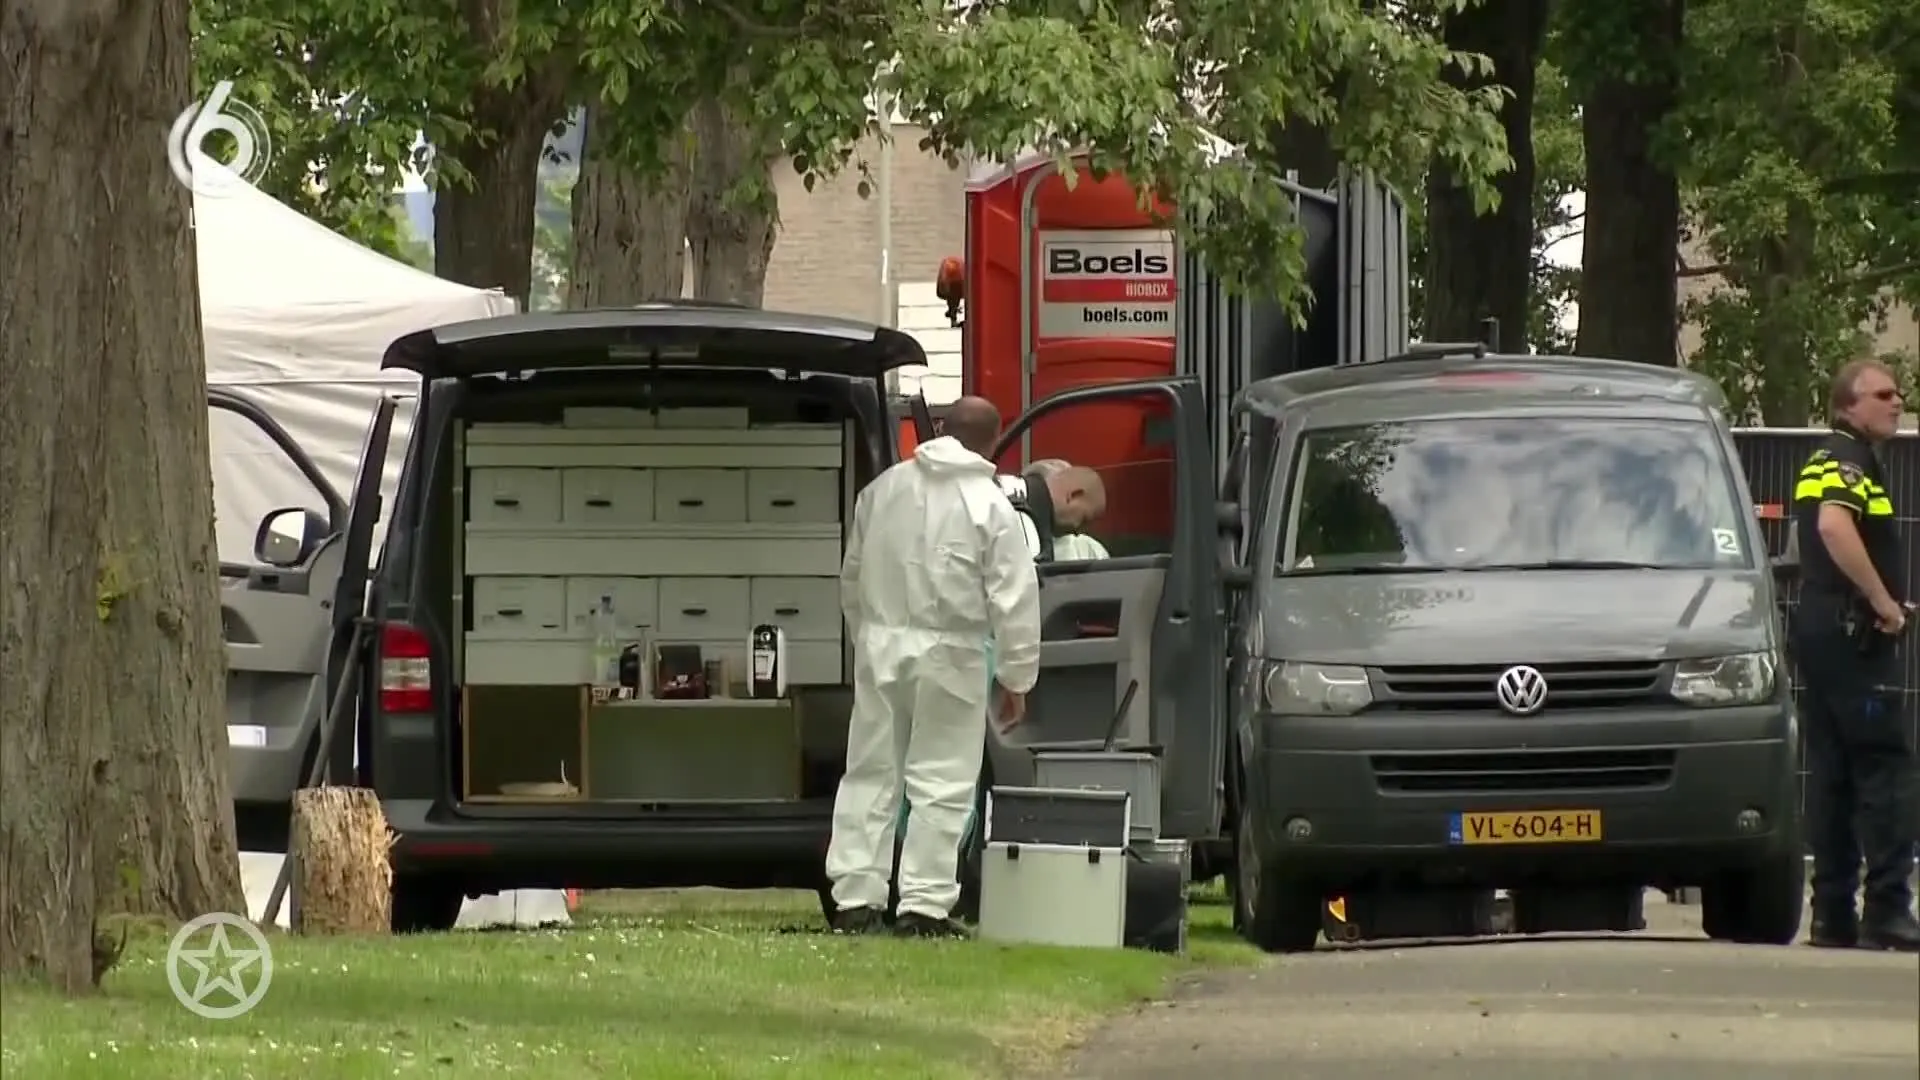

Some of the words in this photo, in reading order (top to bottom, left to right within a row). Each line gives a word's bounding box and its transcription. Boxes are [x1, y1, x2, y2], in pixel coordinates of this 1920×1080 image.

[1050, 248, 1168, 274] Boels
[1083, 307, 1168, 322] boels.com
[1718, 533, 1737, 551] 2
[1470, 814, 1592, 838] VL-604-H
